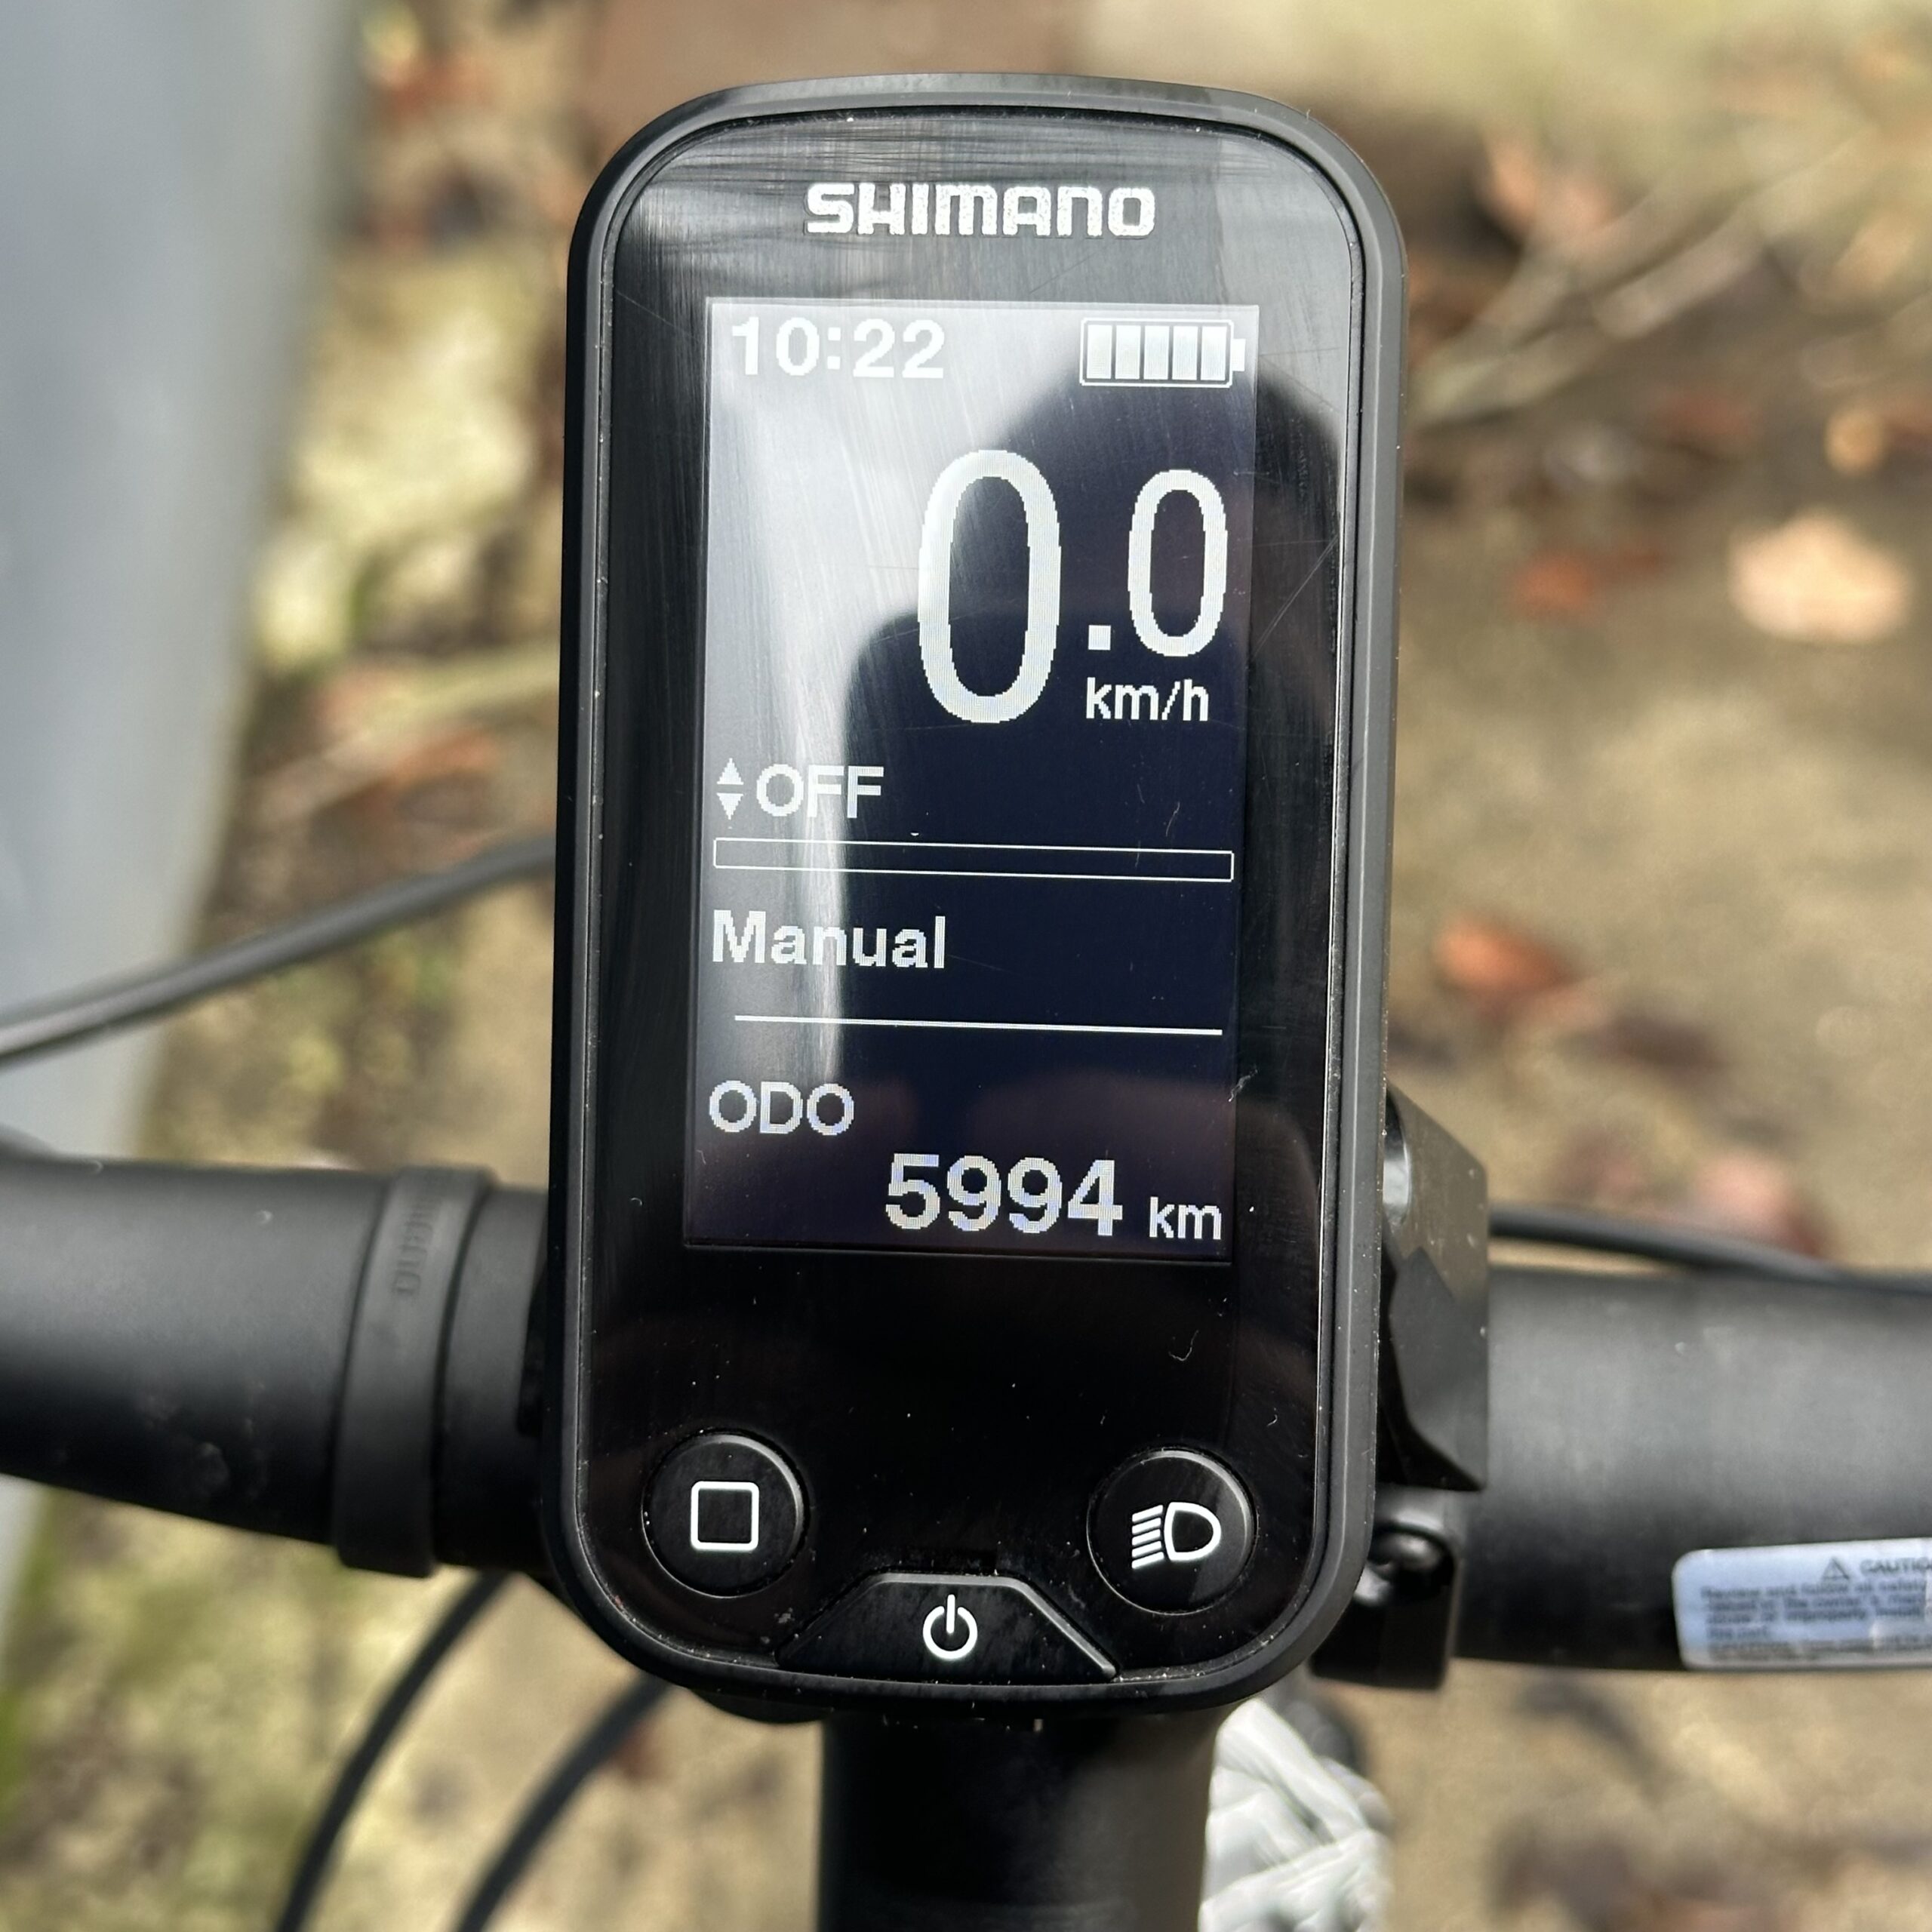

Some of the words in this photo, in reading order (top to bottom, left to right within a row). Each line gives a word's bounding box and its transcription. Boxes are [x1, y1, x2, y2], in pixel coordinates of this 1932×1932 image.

[805, 183, 1155, 237] SHIMANO
[732, 316, 945, 379] 10:22
[918, 450, 1228, 723] 0.0
[1085, 677, 1209, 721] km/h
[755, 764, 884, 819] OFF
[712, 909, 946, 970] Manual
[709, 1080, 855, 1136] ODO
[885, 1152, 1123, 1237] 5994
[1149, 1196, 1223, 1241] km
